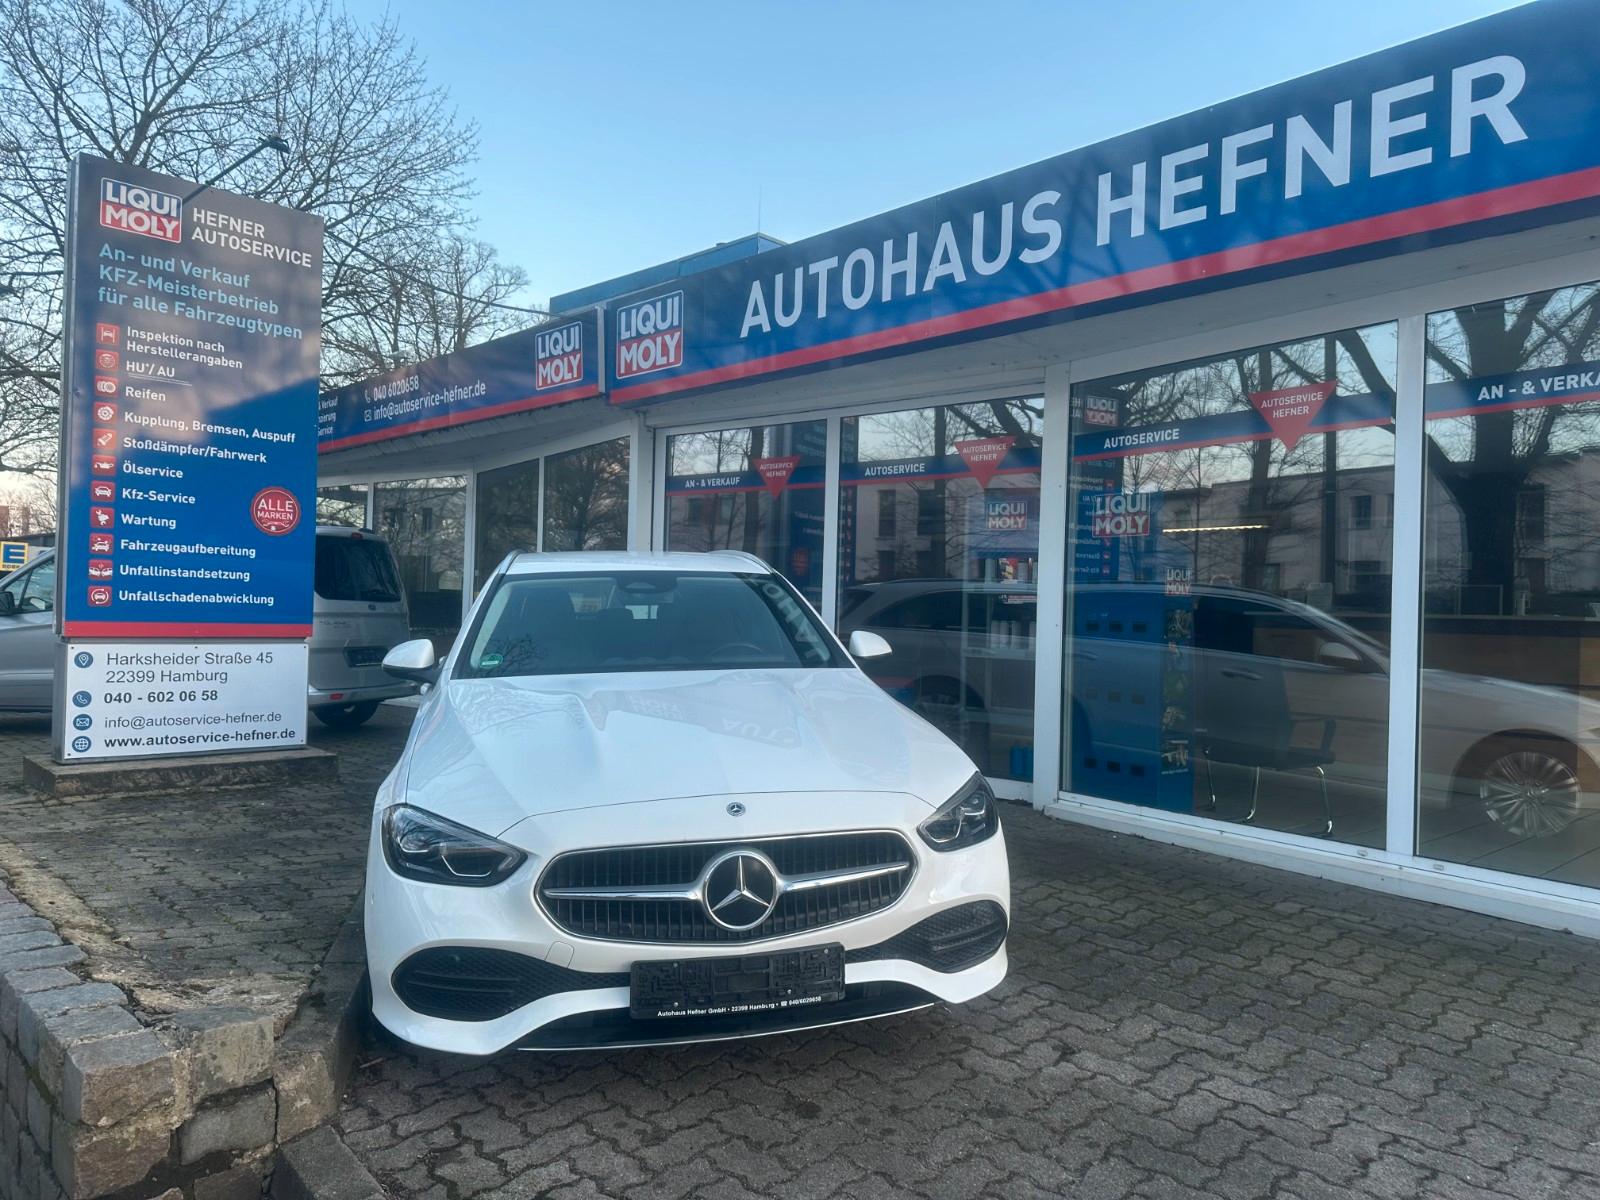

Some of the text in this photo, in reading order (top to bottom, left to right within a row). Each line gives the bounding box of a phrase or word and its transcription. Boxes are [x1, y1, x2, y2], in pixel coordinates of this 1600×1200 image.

[105, 182, 179, 217] LIQUI
[740, 54, 1528, 338] AUTOHAUS HEFNER
[104, 205, 179, 239] MOLY
[192, 208, 265, 238] HEFNER
[191, 230, 312, 268] AUTOSERVICE
[98, 244, 250, 289] An- und Verkauf
[99, 264, 279, 315] KFZ-Meisterbetrieb
[97, 287, 303, 339] für alle Fahrzeugtypen
[619, 305, 680, 340] LIQUI
[127, 326, 225, 353] Inspektion nach
[536, 330, 580, 360] LIQUI
[127, 340, 243, 369] Herstellerangaben
[618, 331, 681, 375] MOLY
[157, 366, 175, 377] AU
[536, 353, 582, 386] MOLY
[125, 386, 166, 401] Reifen
[373, 375, 419, 401] 040 6020658
[1478, 384, 1503, 400] AN
[1522, 381, 1535, 395] &
[1541, 371, 1600, 392] VERKA
[373, 379, 486, 420] info@autoservice-hefner.de
[1261, 391, 1323, 408] AUTOSERVICE
[1272, 405, 1309, 418] HEFNER
[124, 412, 296, 443] Kupplung, Bremsen, Auspuff
[962, 443, 1007, 453] AUTOSERVICE
[1103, 428, 1179, 449] AUTOSERVICE
[123, 437, 267, 463] Stoßdämpfer/Fahrwerk
[970, 453, 997, 462] HEFNER
[122, 461, 184, 479] Ölservice
[864, 463, 926, 477] AUTOSERVICE
[685, 480, 695, 488] AN
[707, 477, 741, 487] VERKAUF
[122, 488, 196, 504] Kfz-Service
[258, 498, 294, 512] ALLE
[1095, 493, 1147, 516] LIQUI
[257, 510, 293, 521] MARKEN
[989, 502, 1025, 516] LIQUI
[121, 514, 177, 529] Wartung
[988, 515, 1025, 529] MOLY
[1095, 515, 1148, 535] MOLY
[120, 539, 256, 558] Fahrzeugaufbereitung
[119, 565, 251, 582] Unfallinstandsetzung
[118, 590, 275, 606] Unfallschadenabwicklung
[106, 652, 273, 666] Harksheider Straße 45
[105, 669, 228, 684] 22399 Hamburg
[104, 692, 132, 704] 040
[147, 691, 175, 703] 602
[180, 690, 198, 702] 06
[201, 689, 218, 701] 58
[104, 711, 282, 730] info@autoservice-hefner.de
[104, 729, 296, 748] www.autoservice-hefner.de
[657, 1009, 686, 1017] Autohaus
[749, 1002, 775, 1011] Hamburg
